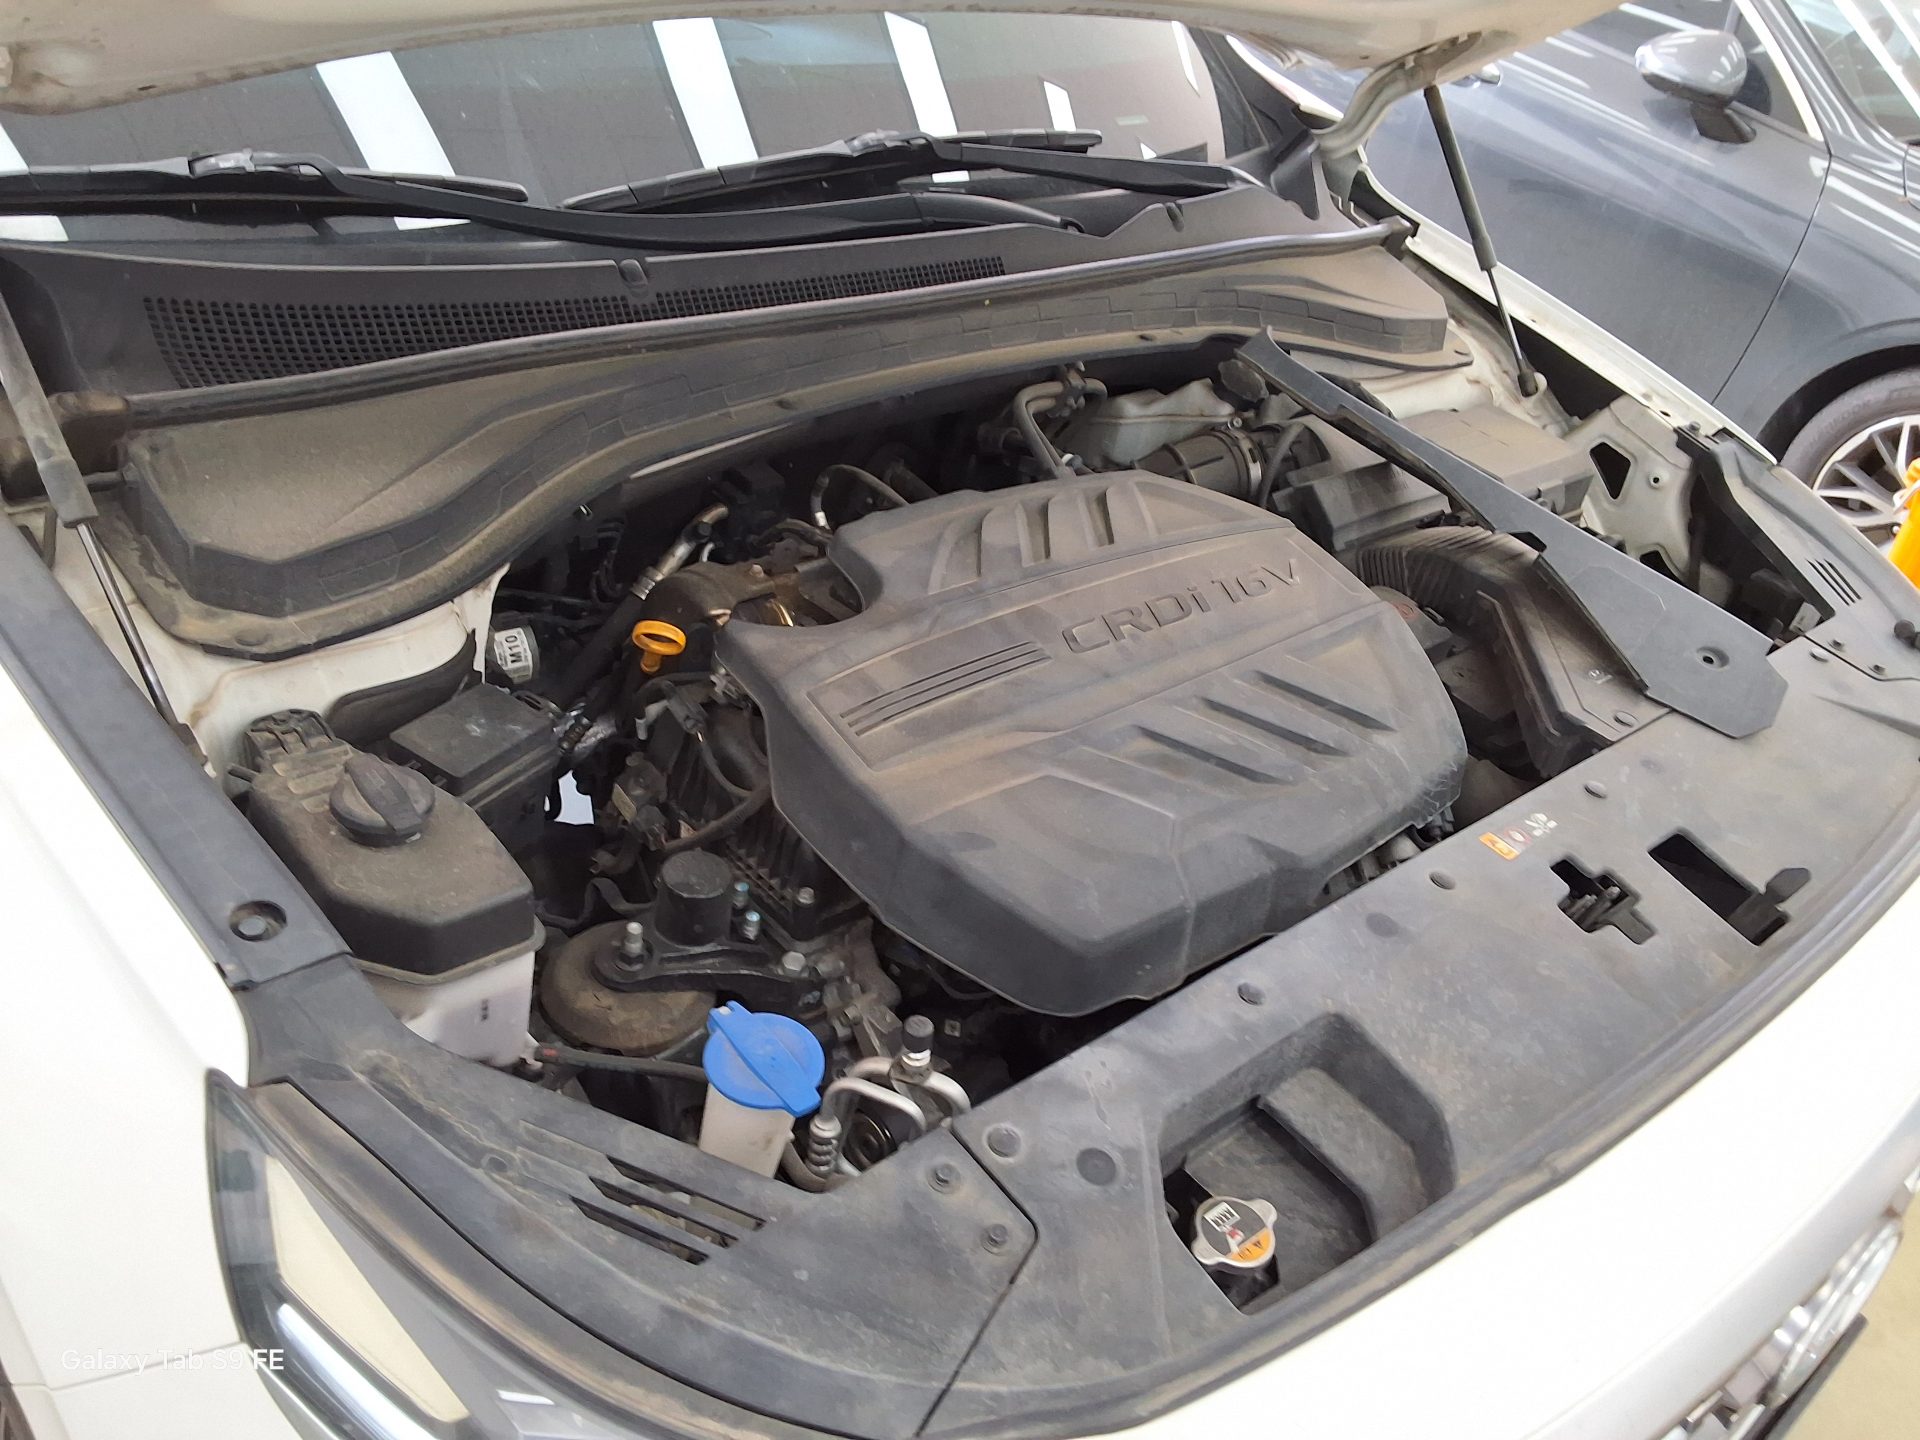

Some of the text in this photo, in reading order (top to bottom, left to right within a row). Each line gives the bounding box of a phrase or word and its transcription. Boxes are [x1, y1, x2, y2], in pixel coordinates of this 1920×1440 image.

[1061, 559, 1300, 654] CRDi 16V
[505, 635, 523, 664] M10
